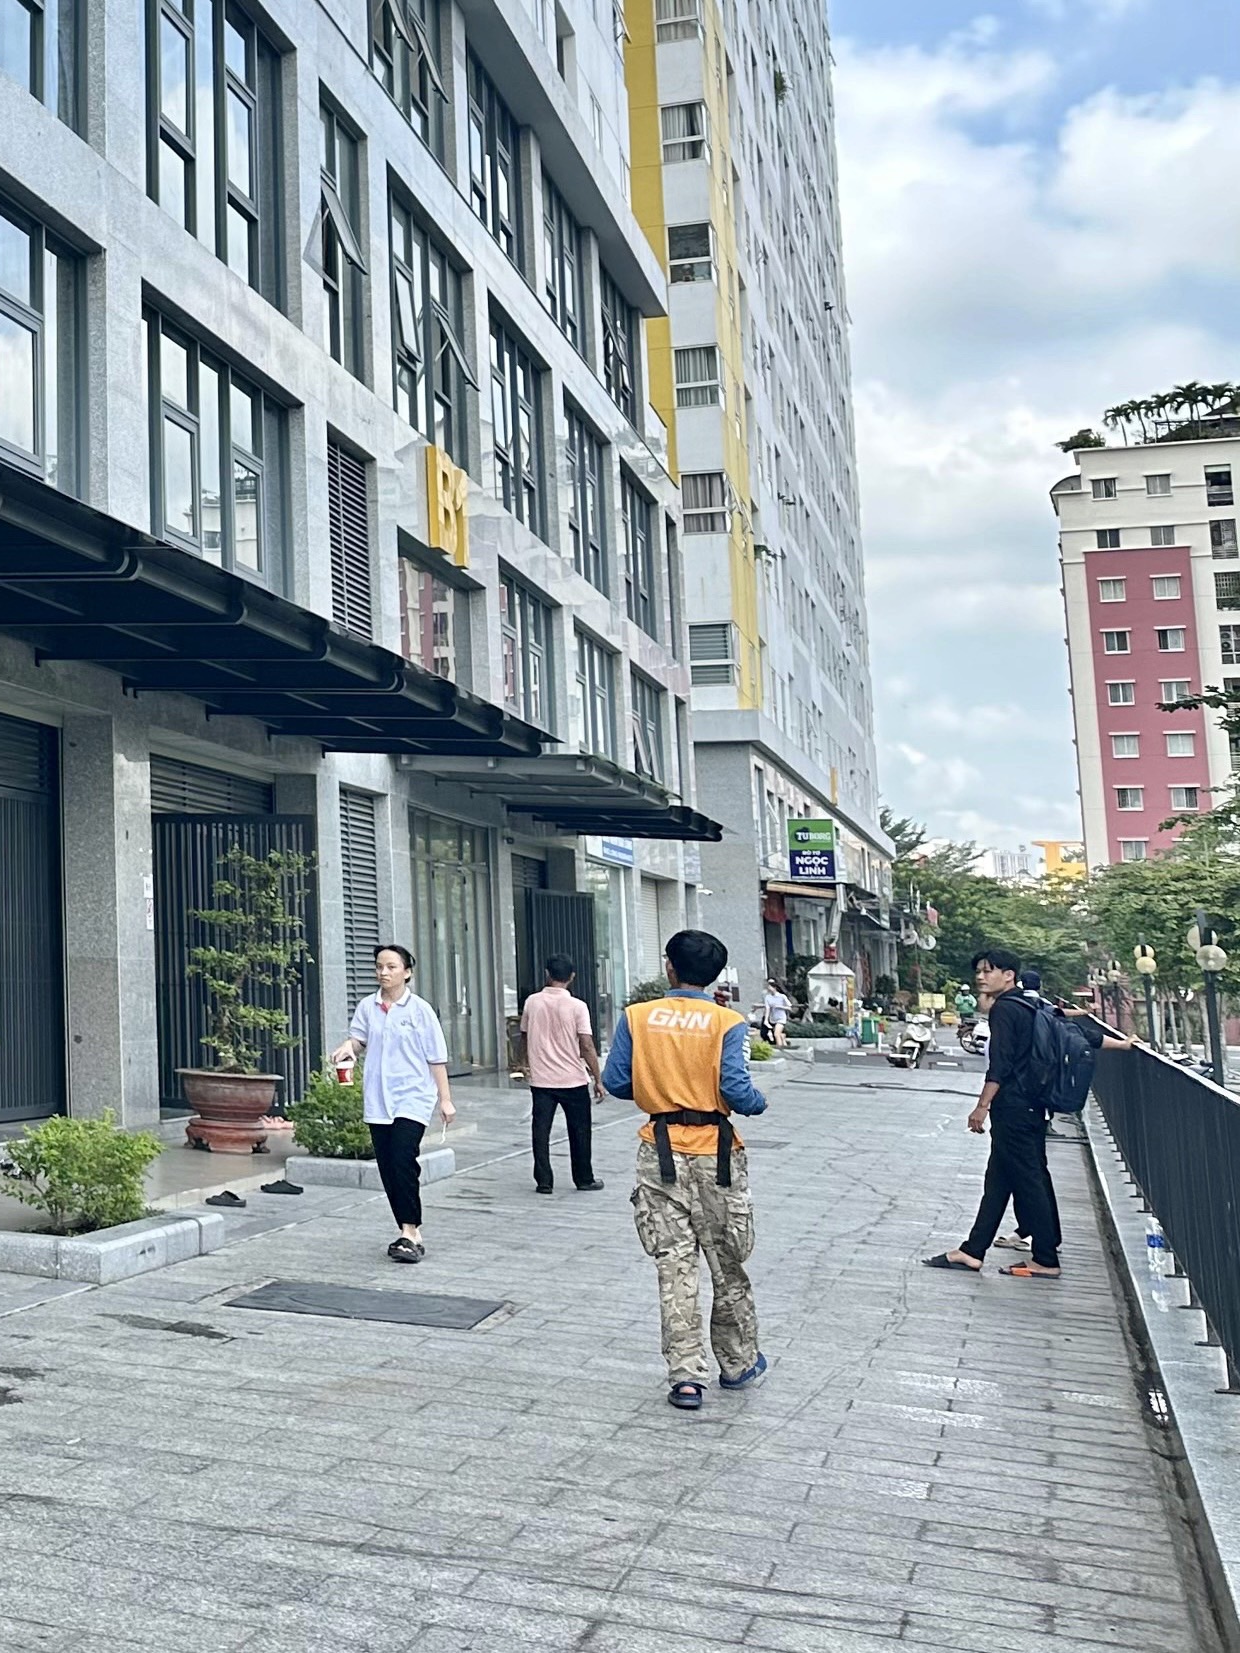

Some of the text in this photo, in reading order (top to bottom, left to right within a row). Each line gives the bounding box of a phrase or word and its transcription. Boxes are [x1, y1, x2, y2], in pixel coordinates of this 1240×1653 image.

[795, 831, 832, 841] TUBORG
[795, 856, 829, 867] NGỌC
[799, 866, 826, 875] LINH
[647, 1007, 712, 1031] GHN
